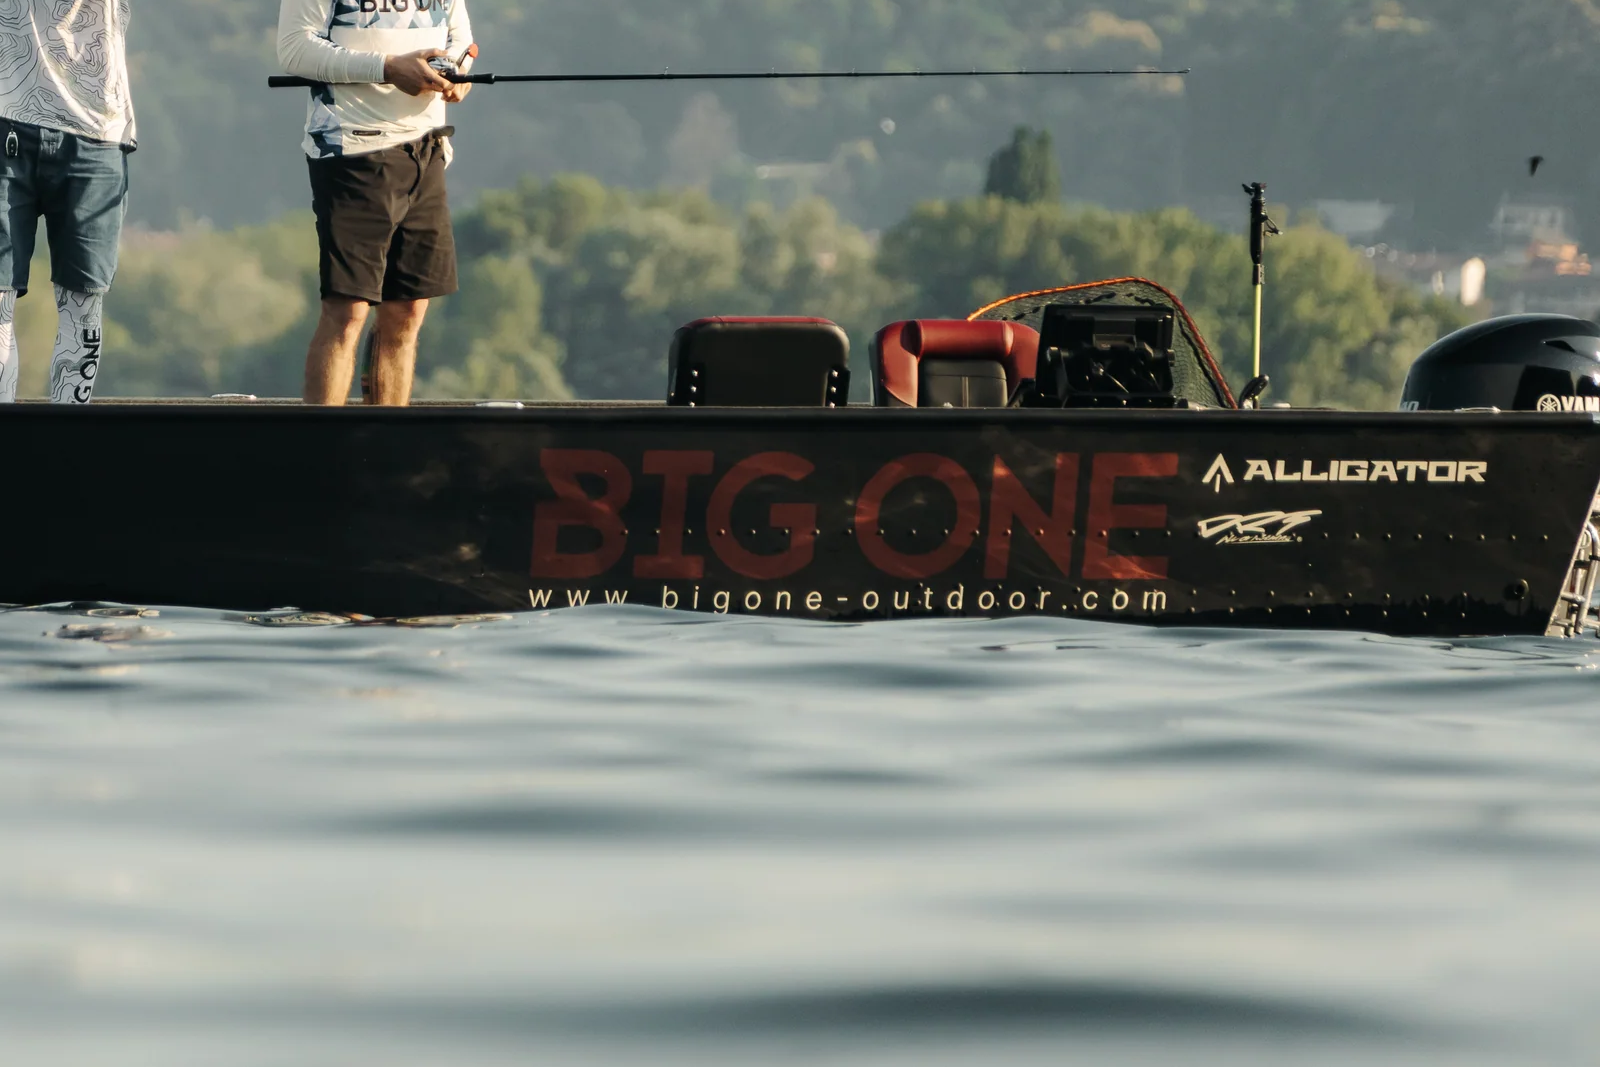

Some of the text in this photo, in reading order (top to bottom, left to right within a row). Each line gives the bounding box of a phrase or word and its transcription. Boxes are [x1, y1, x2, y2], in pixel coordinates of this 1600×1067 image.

[79, 328, 101, 381] ONE
[1243, 459, 1488, 483] ALLIGATOR
[529, 448, 1180, 581] BIG ONE
